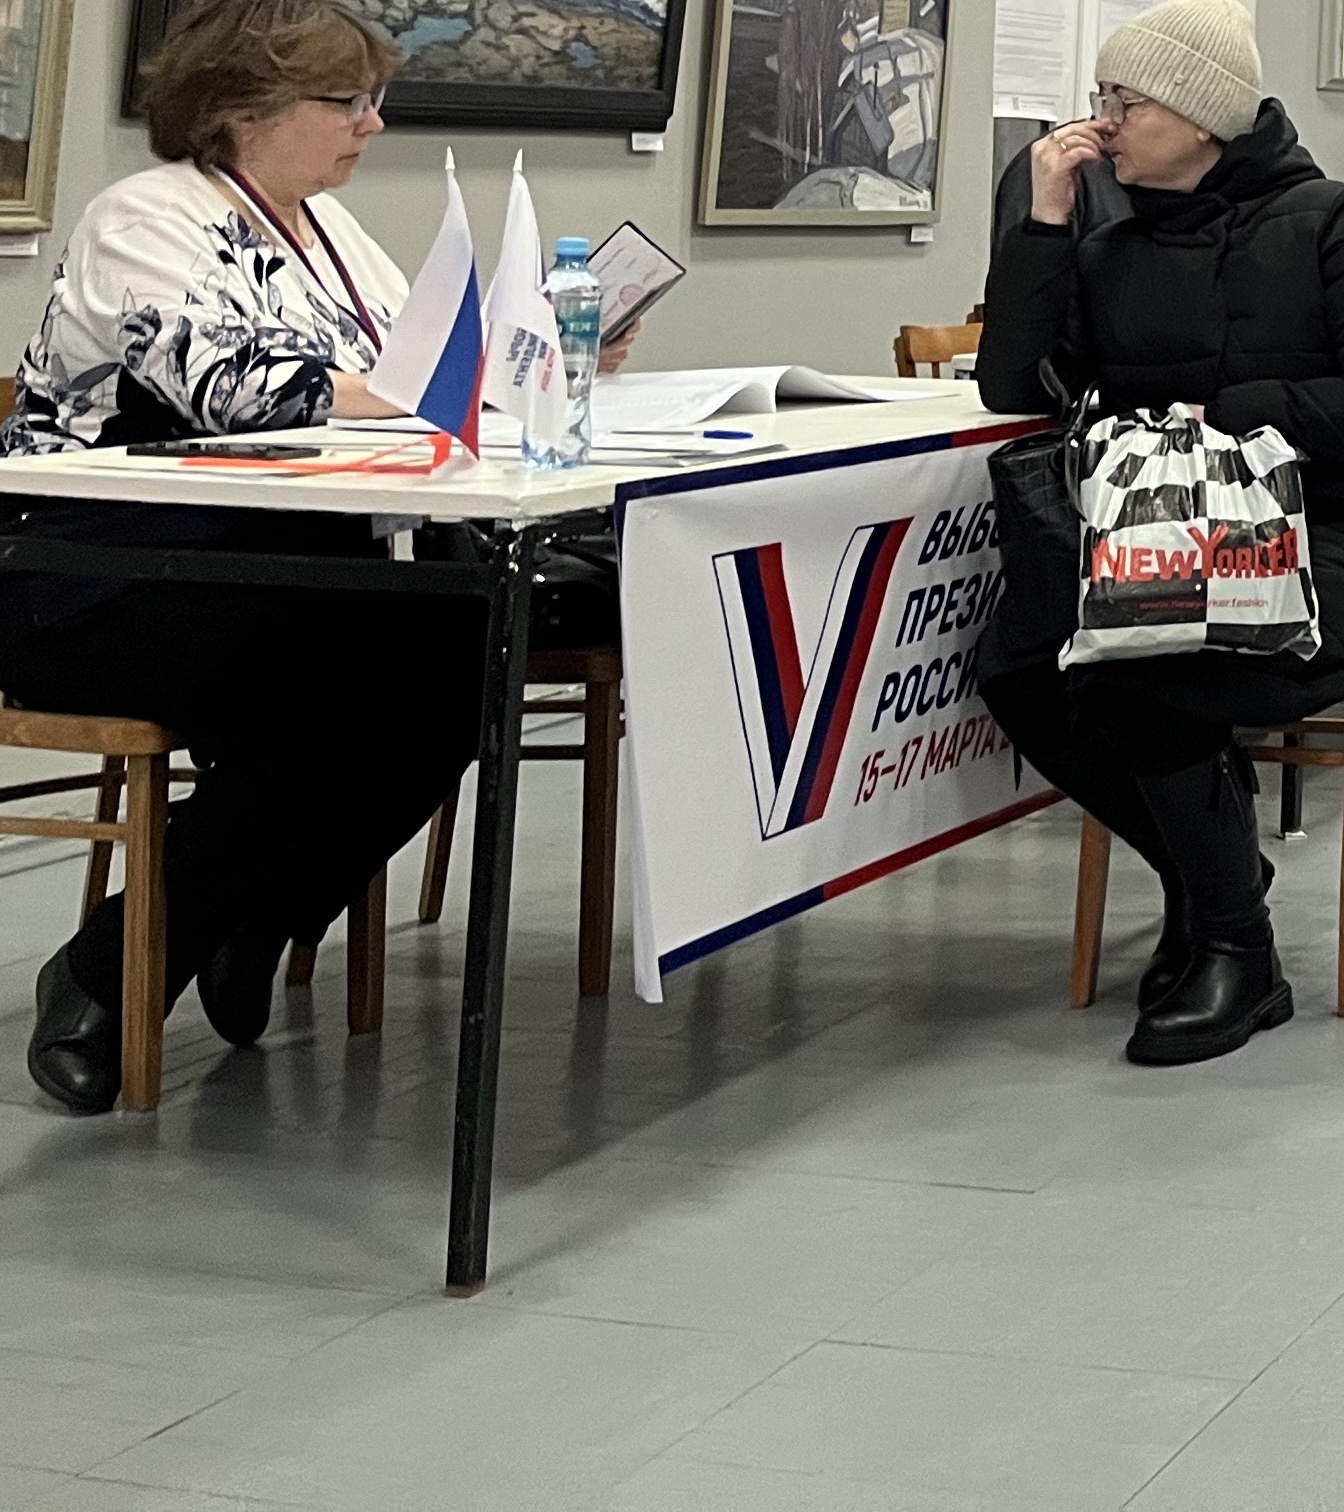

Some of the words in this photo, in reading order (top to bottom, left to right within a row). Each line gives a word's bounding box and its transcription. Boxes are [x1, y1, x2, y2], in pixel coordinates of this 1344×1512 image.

[918, 500, 1000, 566] ВЫБ
[895, 568, 1002, 648] ПРЕЗИ
[871, 648, 977, 732] РОССИ
[920, 714, 996, 780] МАРТА
